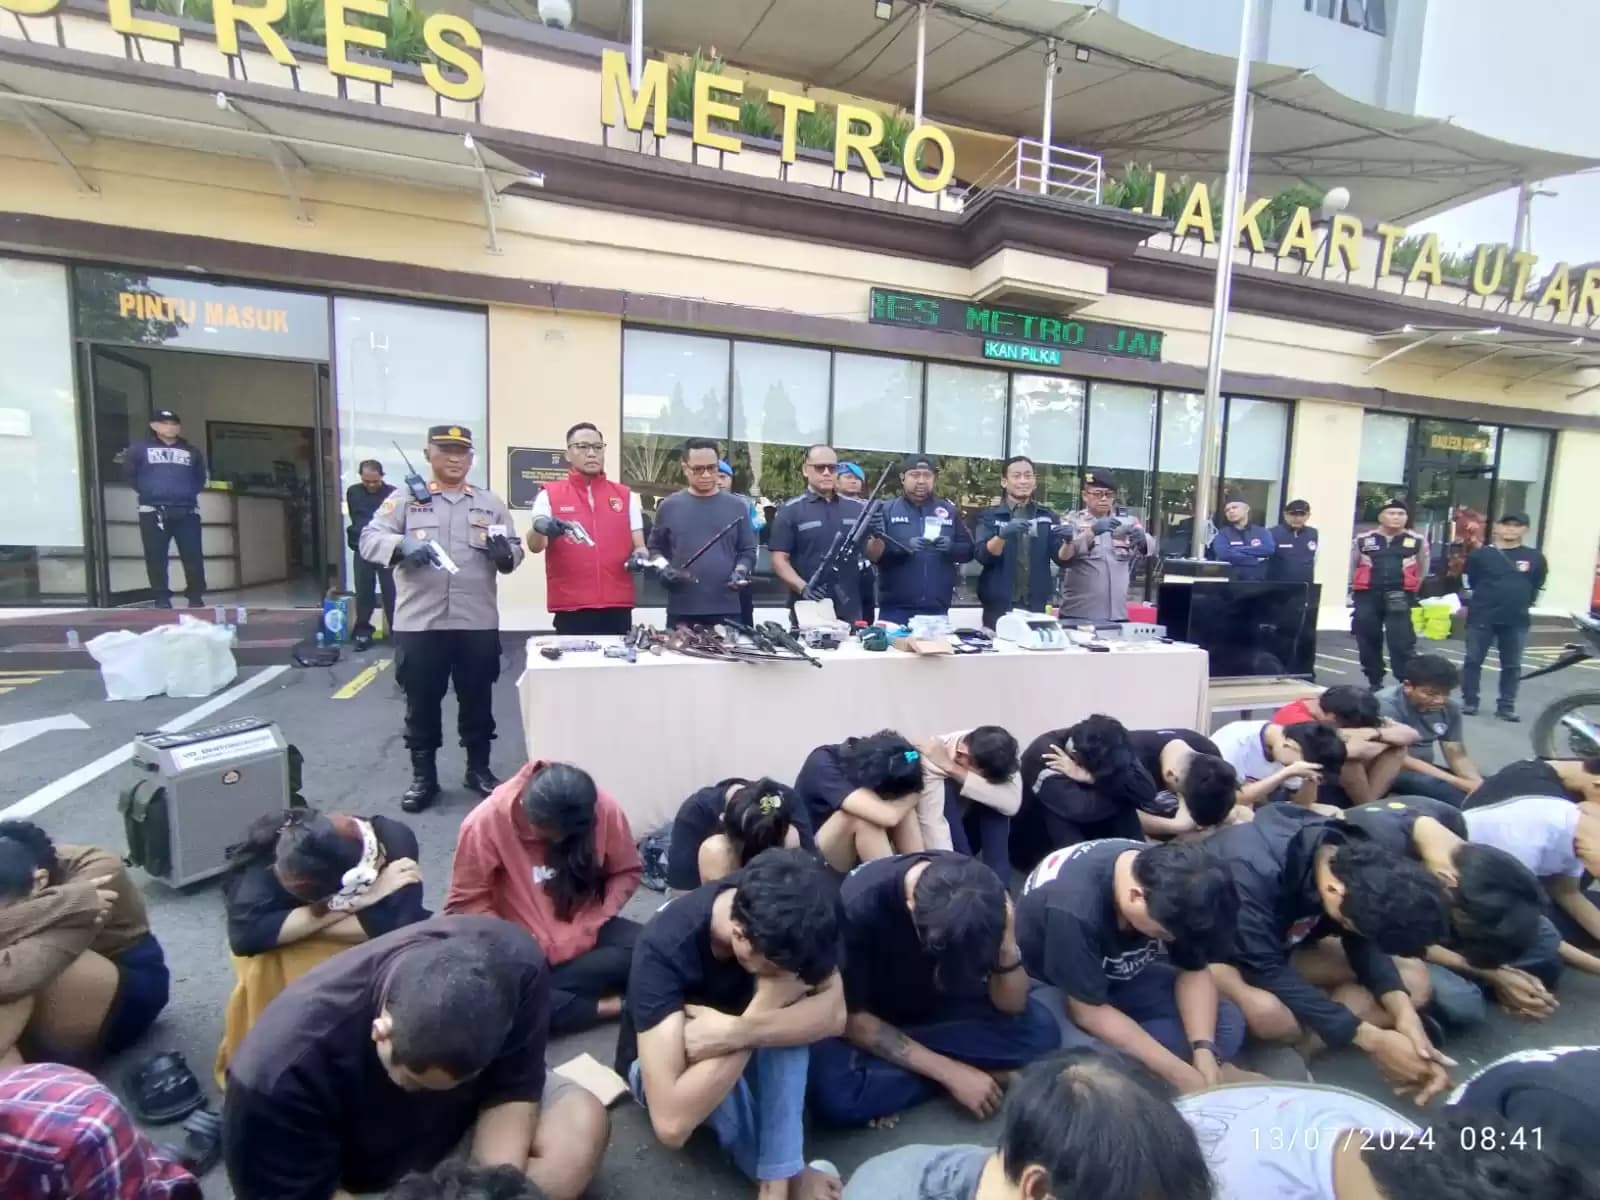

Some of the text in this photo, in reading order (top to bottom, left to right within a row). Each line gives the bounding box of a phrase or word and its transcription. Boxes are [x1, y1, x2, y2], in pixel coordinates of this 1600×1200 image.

[601, 48, 955, 193] METRO
[1131, 172, 1443, 287] JAKARTA
[119, 292, 289, 333] PINTU MASUK
[966, 305, 1085, 346] METRO
